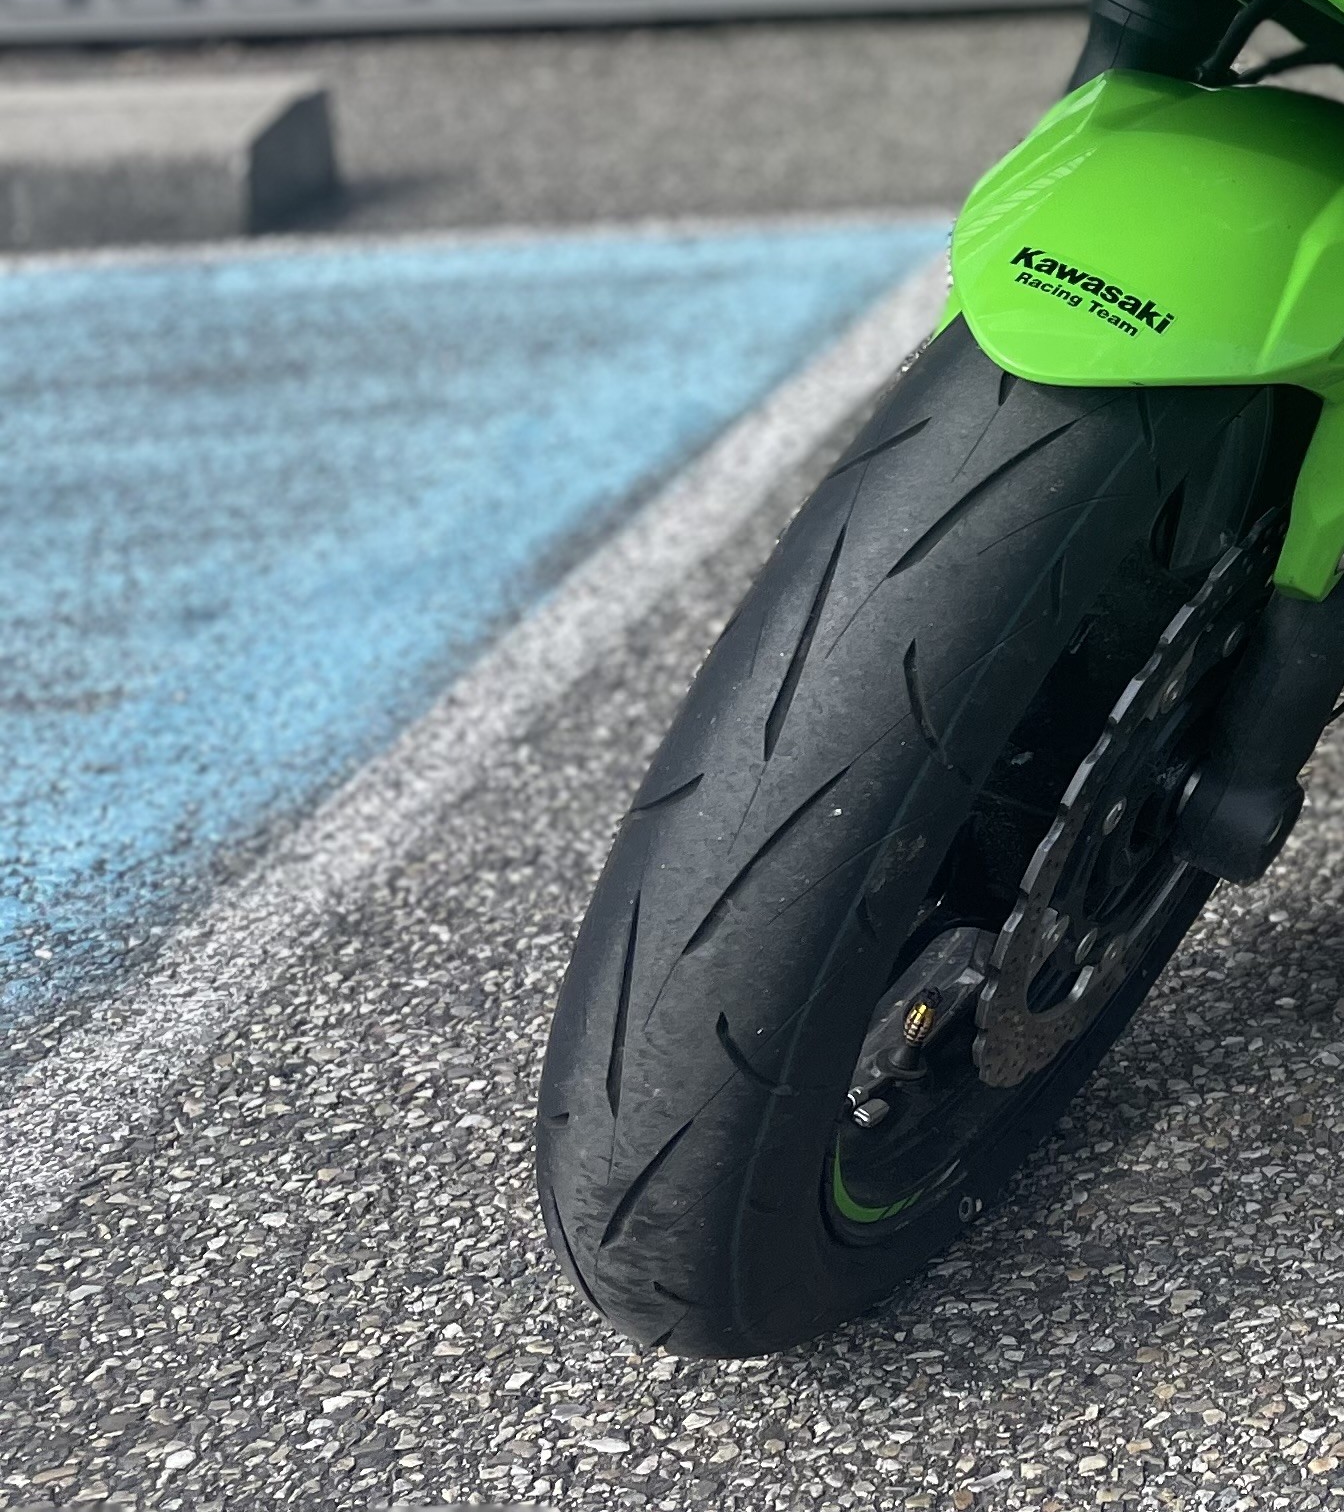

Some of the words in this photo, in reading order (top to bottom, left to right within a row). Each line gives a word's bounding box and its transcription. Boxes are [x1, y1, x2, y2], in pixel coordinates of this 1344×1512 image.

[1010, 246, 1175, 335] Kawasaki
[1014, 271, 1084, 308] Racing
[1088, 299, 1139, 337] Team
